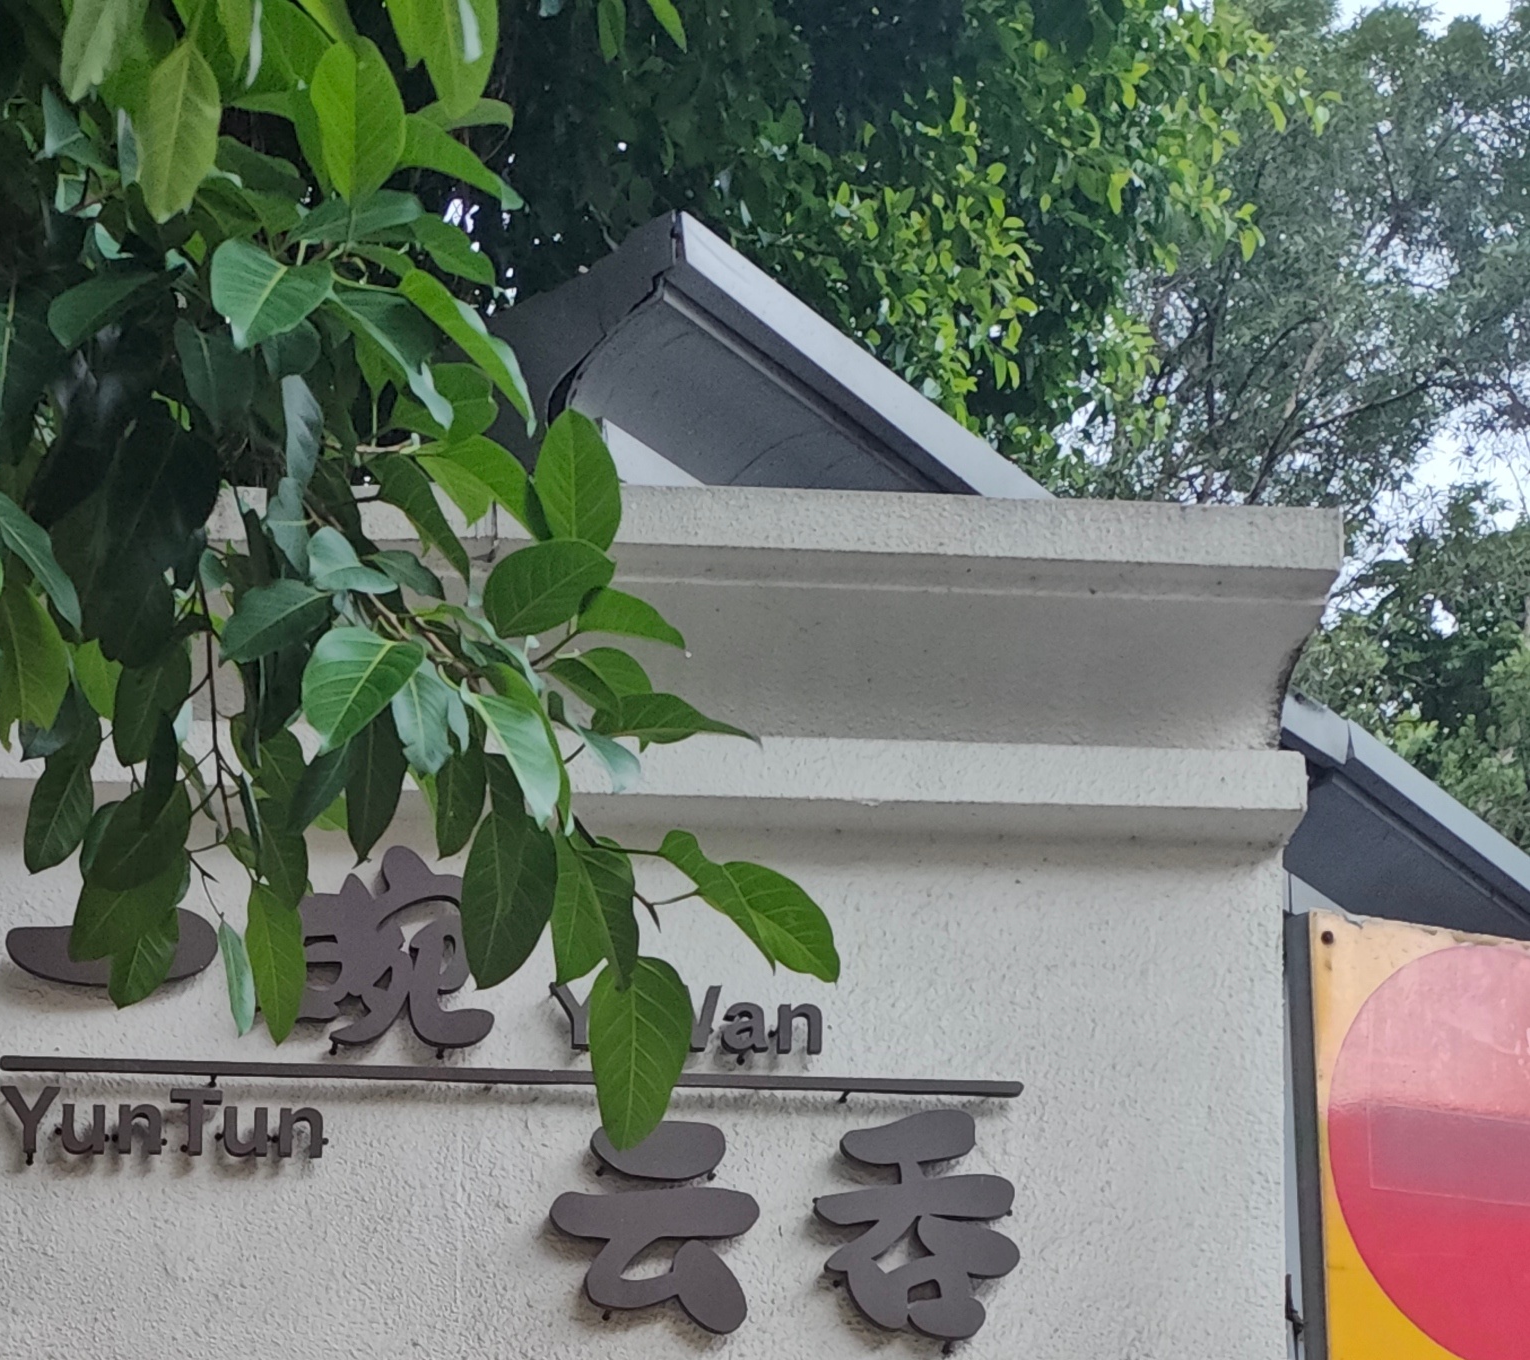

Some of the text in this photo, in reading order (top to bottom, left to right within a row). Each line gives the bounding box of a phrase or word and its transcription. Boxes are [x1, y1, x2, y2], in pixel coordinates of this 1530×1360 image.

[549, 982, 823, 1055] Yan
[1, 1086, 325, 1159] YunTun
[549, 1109, 1020, 1340] 云吞
